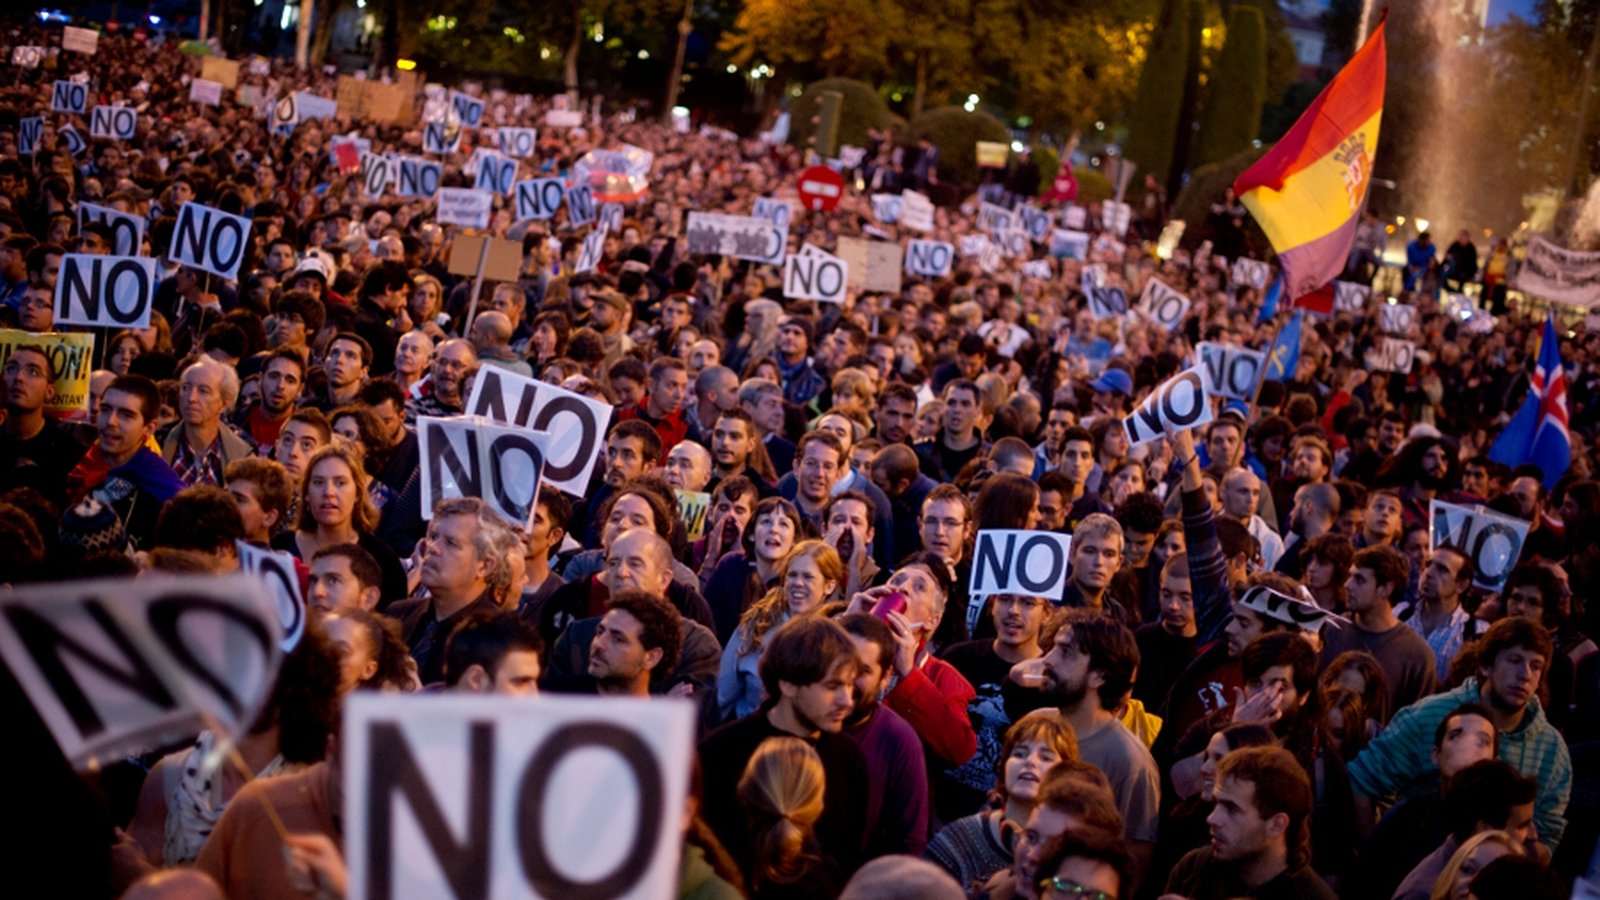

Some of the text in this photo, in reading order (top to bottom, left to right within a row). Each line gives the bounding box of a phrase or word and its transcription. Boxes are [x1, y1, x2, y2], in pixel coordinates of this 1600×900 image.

[54, 88, 84, 111] NO
[454, 97, 481, 124] NO
[94, 110, 133, 135] NO
[500, 131, 532, 155] NO
[361, 154, 387, 193] NO
[400, 161, 439, 197] NO
[480, 154, 515, 194] NO
[519, 181, 564, 217] NO
[174, 206, 243, 272] NO
[1019, 207, 1049, 236] NO
[790, 256, 843, 297] NO
[912, 244, 949, 271] NO
[60, 258, 149, 324] NO
[1091, 287, 1128, 314] NO
[1148, 283, 1183, 323] NO
[1202, 347, 1258, 395] NO
[474, 371, 597, 482] NO
[1125, 371, 1204, 442] NO
[427, 424, 544, 520] NO
[973, 533, 1063, 593] NO
[2, 595, 274, 740] NO
[366, 718, 666, 900] NO
